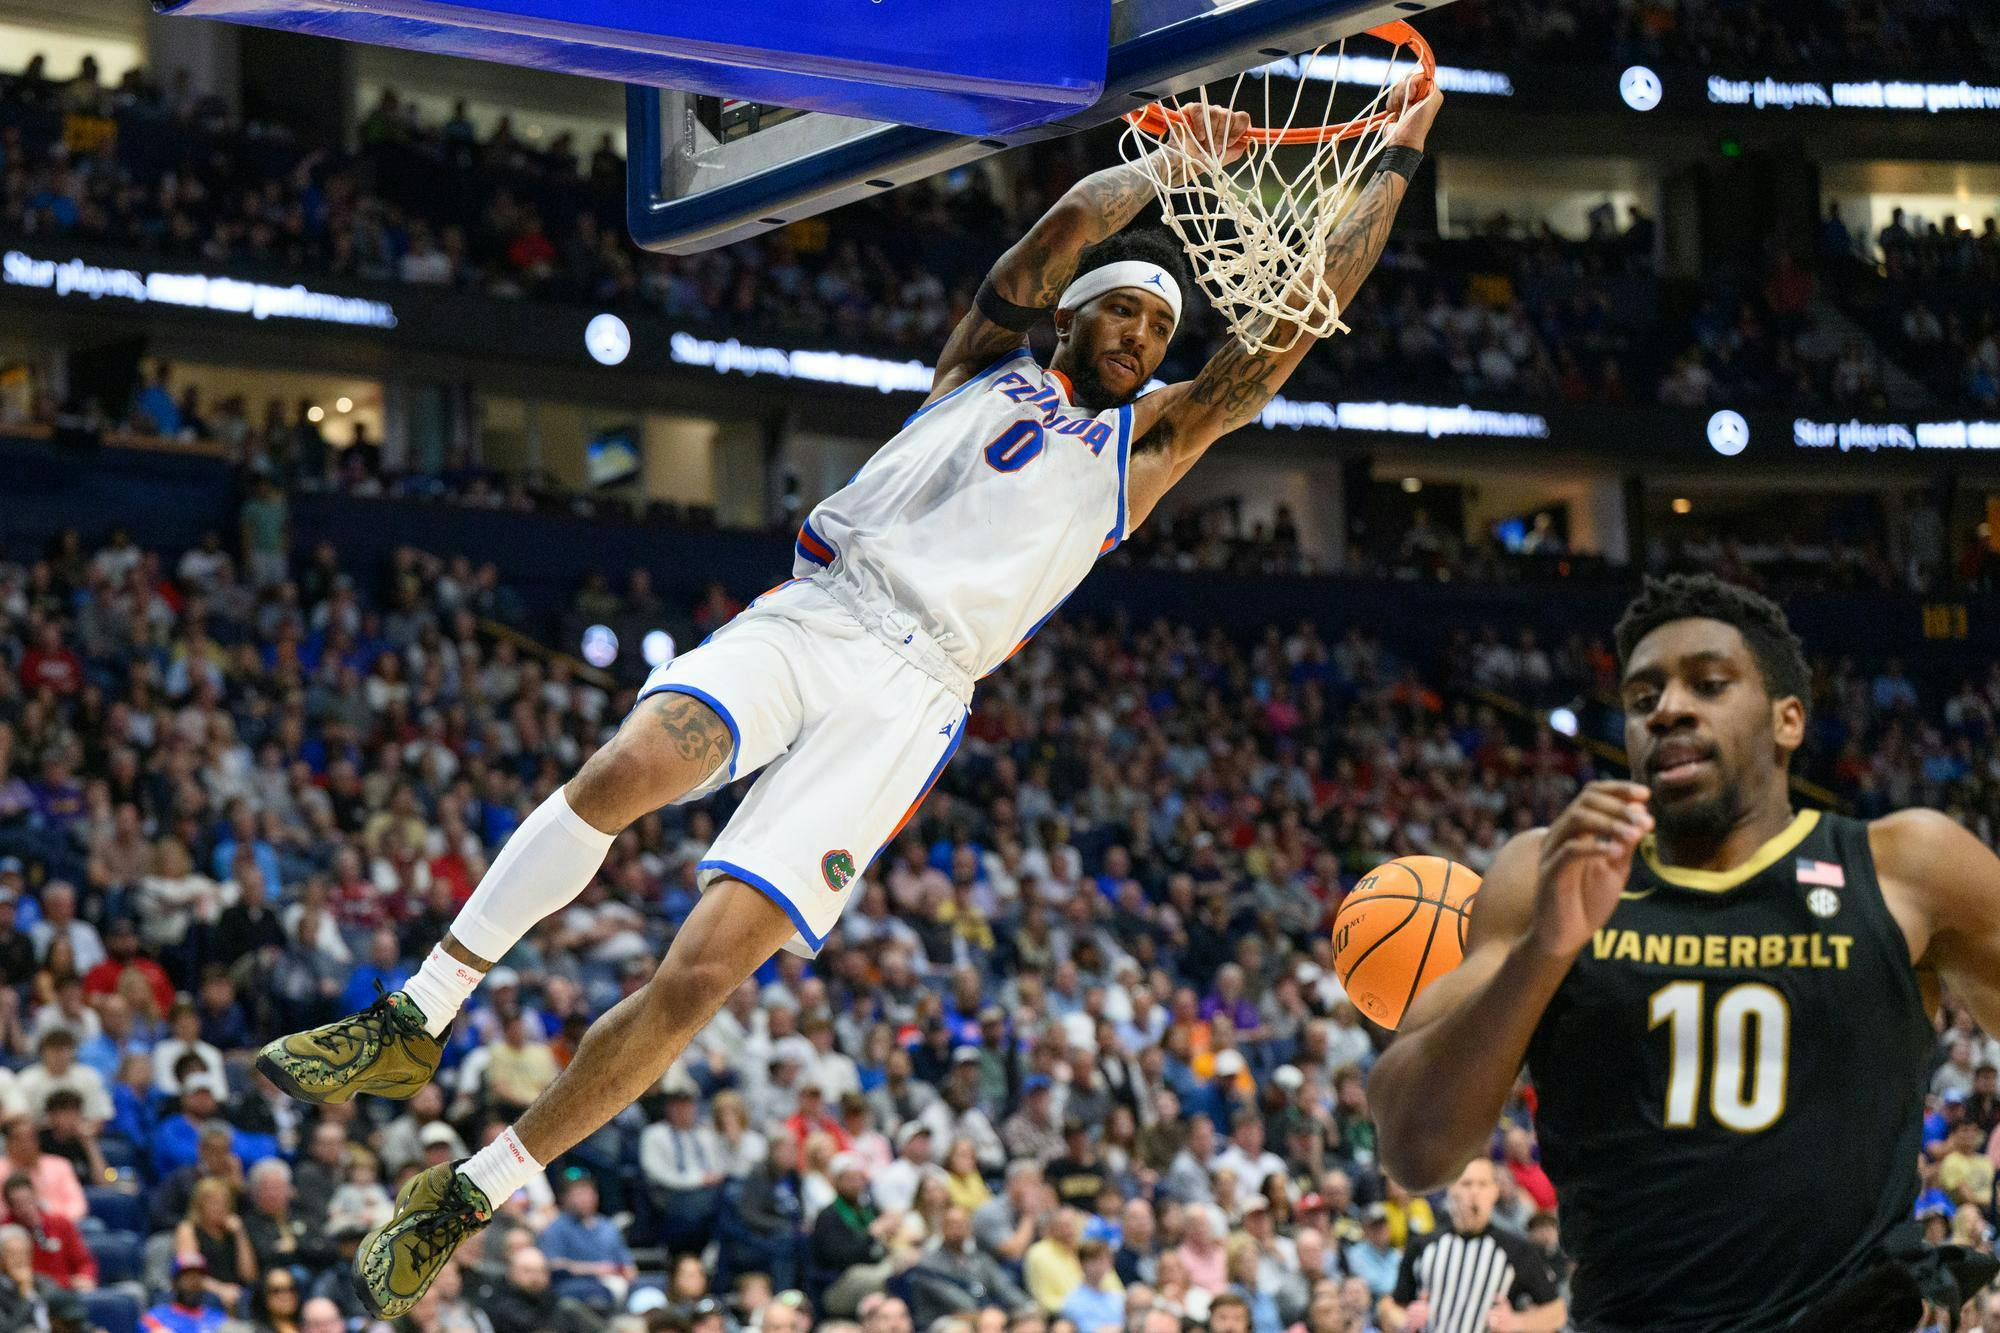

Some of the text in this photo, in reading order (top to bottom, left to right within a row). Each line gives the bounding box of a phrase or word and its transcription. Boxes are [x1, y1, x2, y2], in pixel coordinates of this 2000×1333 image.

[984, 419, 1043, 473] 0
[1592, 929, 1855, 970] VANDERBILT
[1647, 979, 1791, 1134] 10
